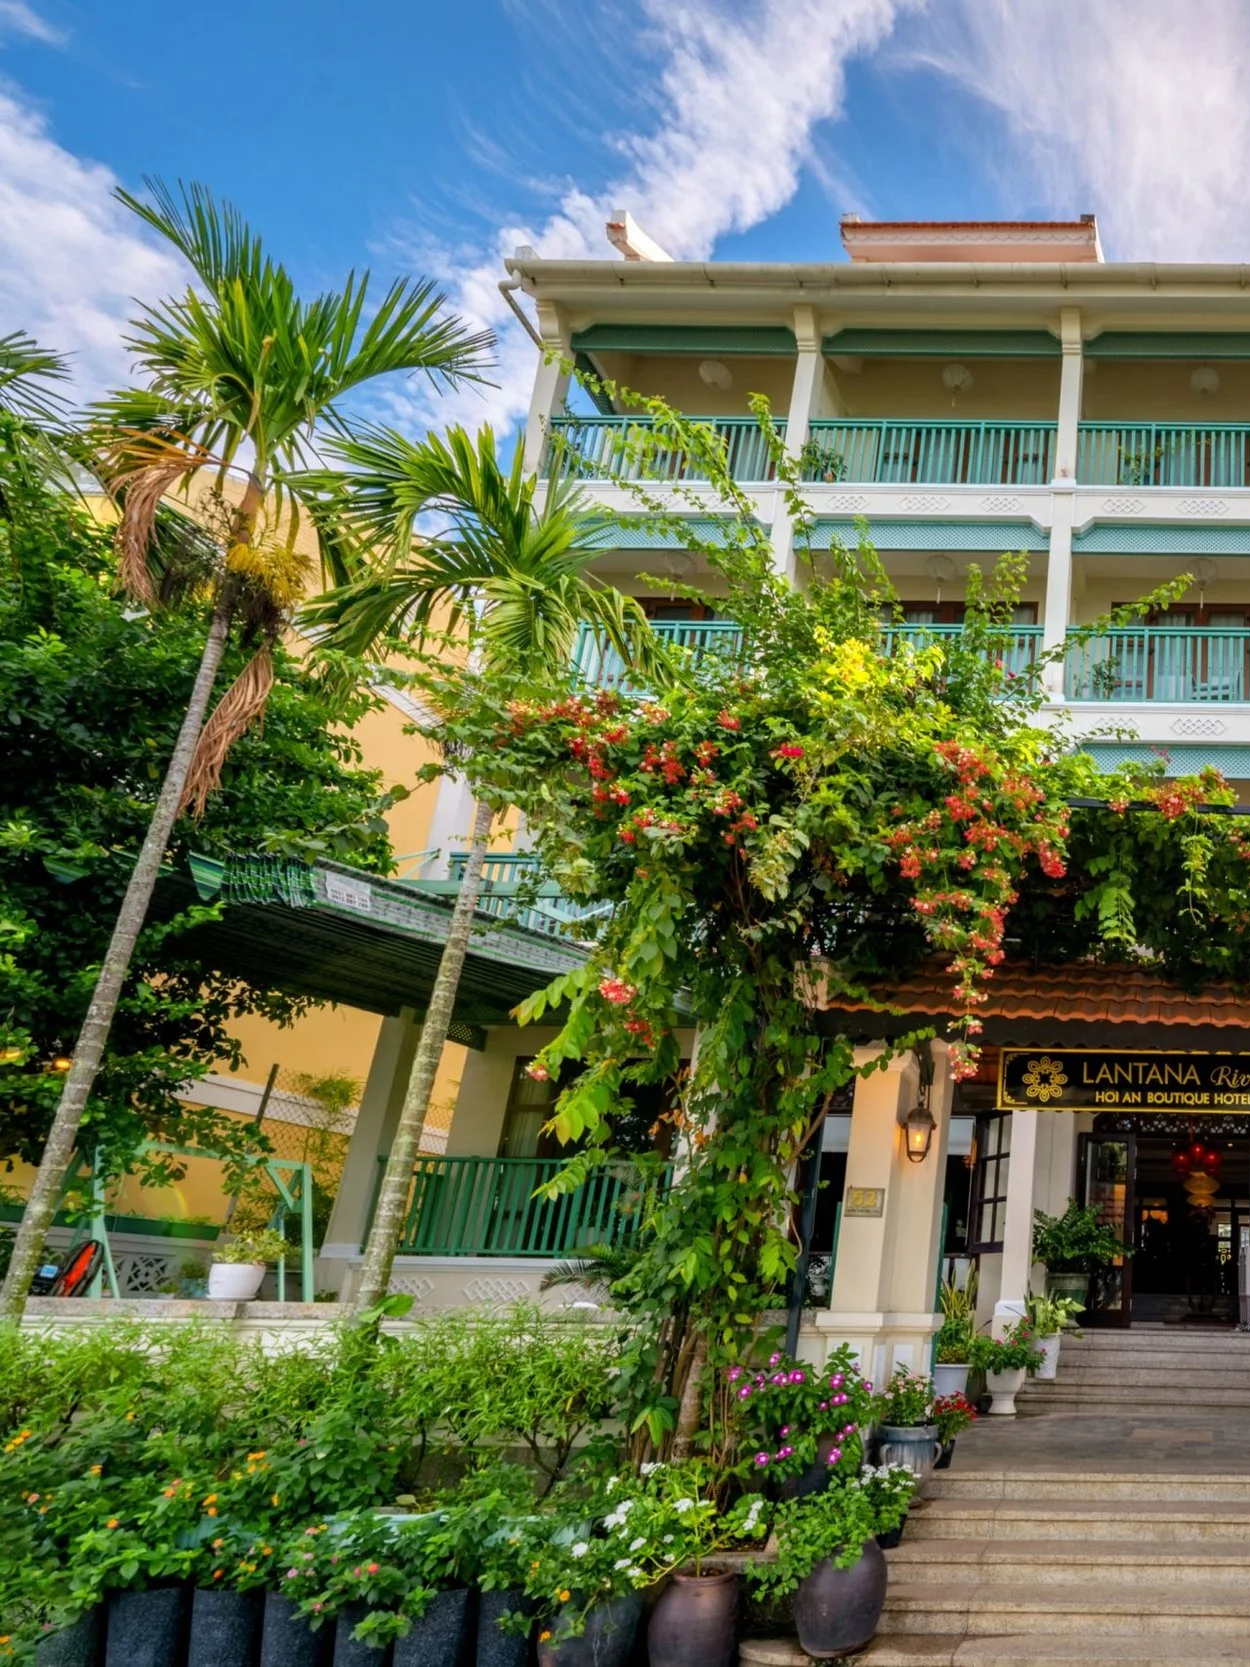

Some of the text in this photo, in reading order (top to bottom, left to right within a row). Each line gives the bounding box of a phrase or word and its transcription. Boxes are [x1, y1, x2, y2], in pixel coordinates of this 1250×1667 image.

[1083, 1062, 1200, 1085] LANTANA
[1095, 1091, 1119, 1103] HOI
[1122, 1092, 1141, 1104] AN
[1147, 1092, 1210, 1105] BOUTIQUE
[853, 1190, 877, 1207] 52
